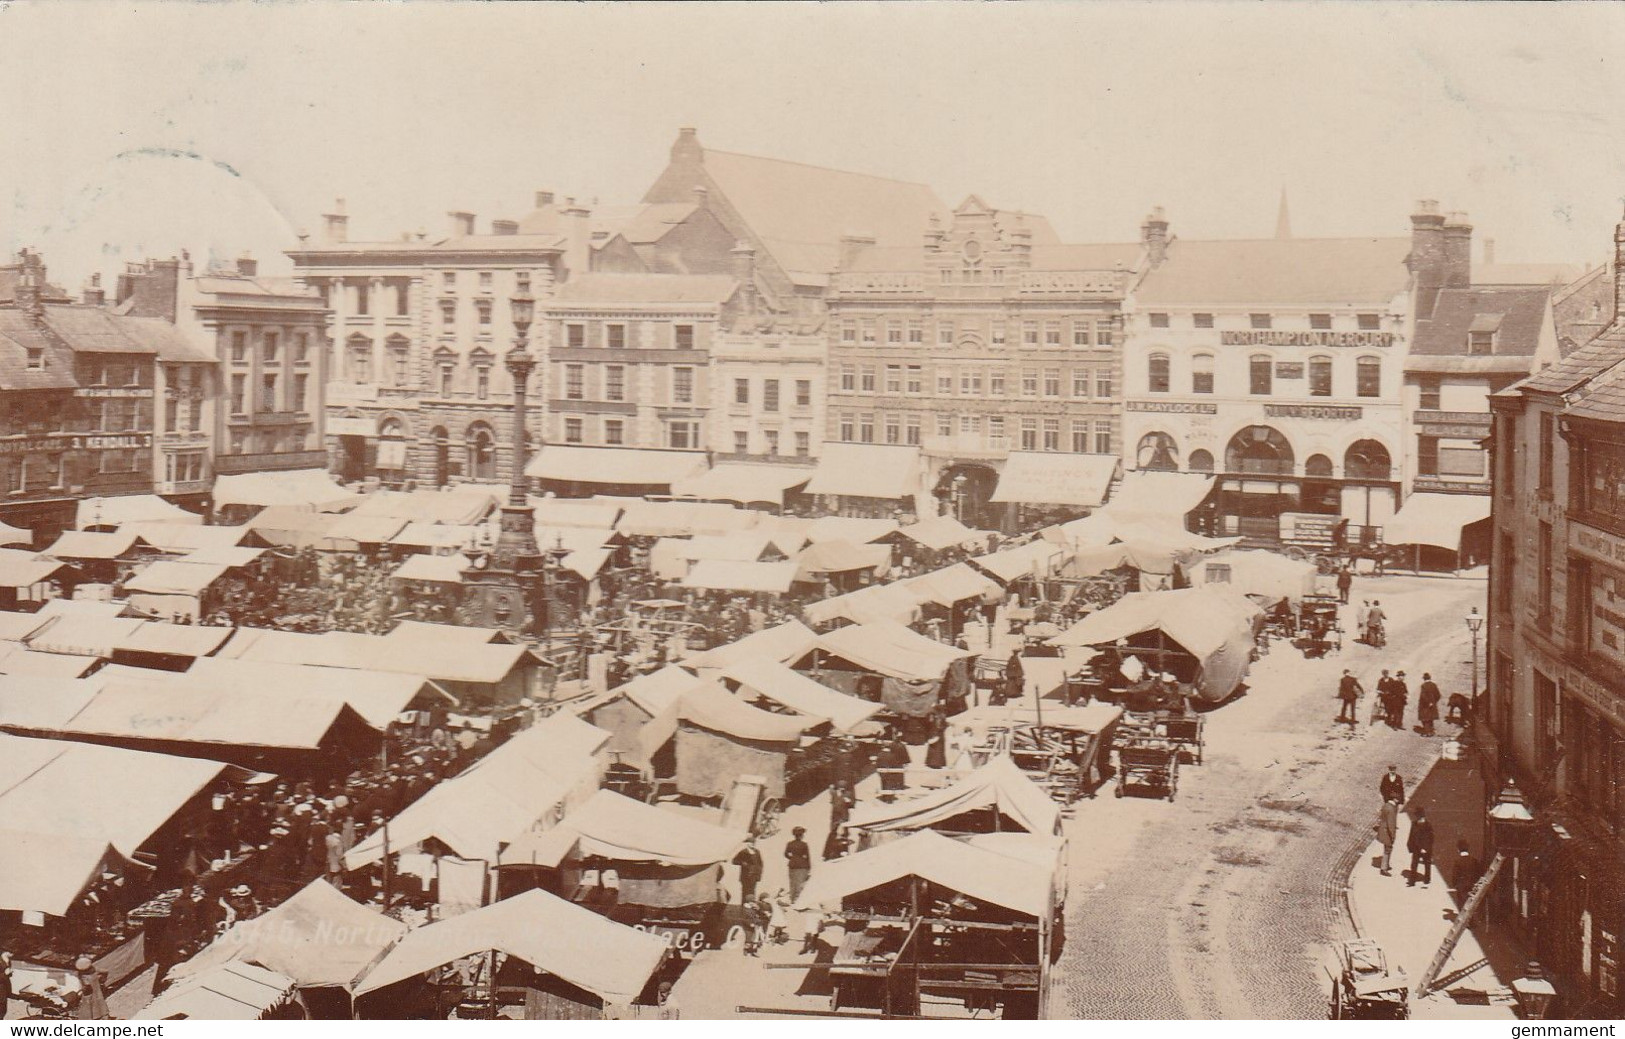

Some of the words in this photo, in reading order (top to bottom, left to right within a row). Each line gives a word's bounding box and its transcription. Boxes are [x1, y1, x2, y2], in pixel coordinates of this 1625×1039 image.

[1221, 331, 1322, 346] NORTHAMPTON
[1327, 332, 1392, 347] MERCURY
[1302, 407, 1362, 420] REPORTER
